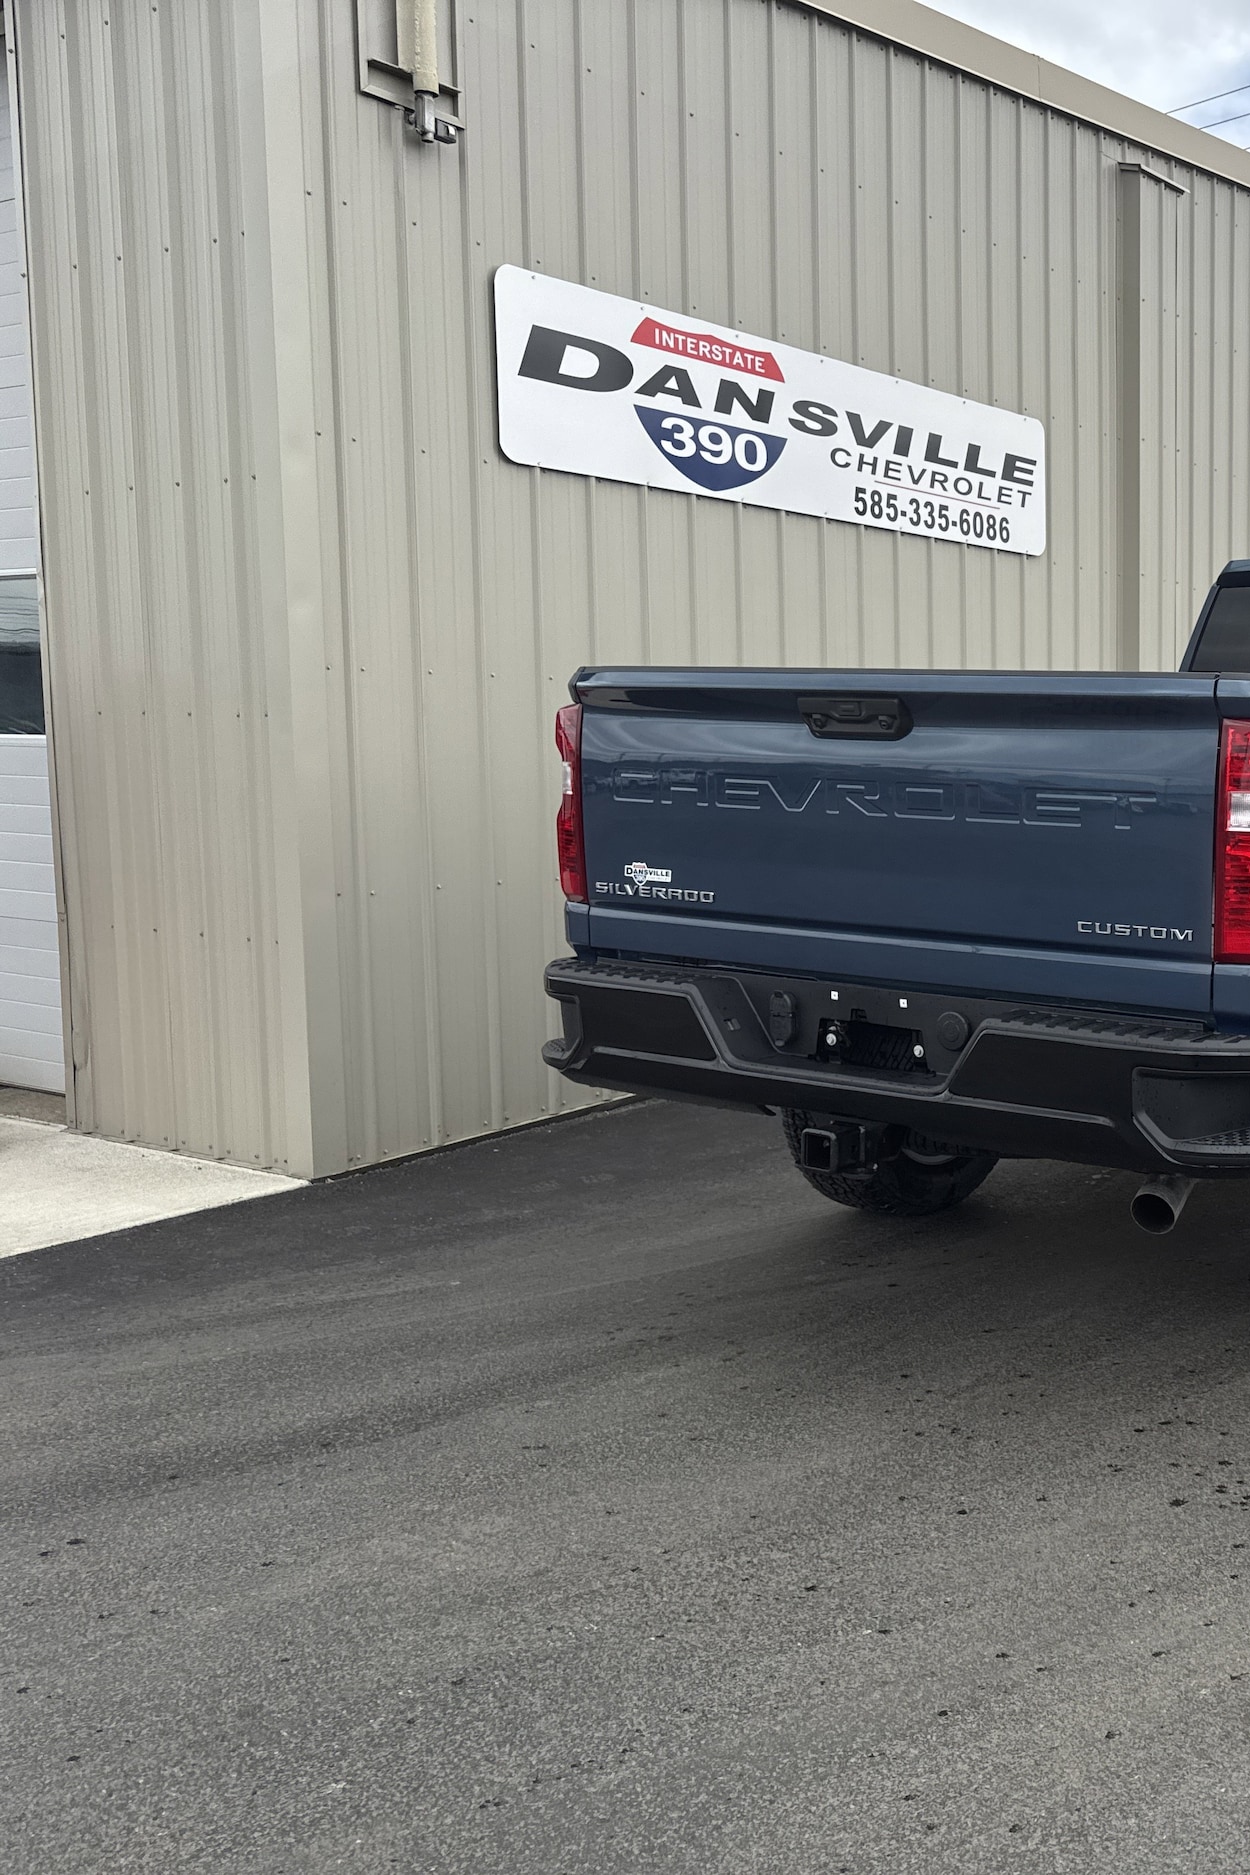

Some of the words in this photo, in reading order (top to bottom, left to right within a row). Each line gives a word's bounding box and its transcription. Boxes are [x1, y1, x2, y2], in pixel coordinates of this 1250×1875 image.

[653, 327, 767, 374] INTERSTATE
[517, 324, 1037, 488] DANSVILLE
[660, 416, 769, 473] 390
[829, 447, 1032, 509] CHEVROLET
[853, 486, 1011, 544] 585-335-6086
[613, 768, 1157, 832] CHEVROLET
[595, 881, 715, 903] SILVERADO
[626, 867, 671, 878] DANSVILLE
[1077, 921, 1194, 942] CUSTOM
